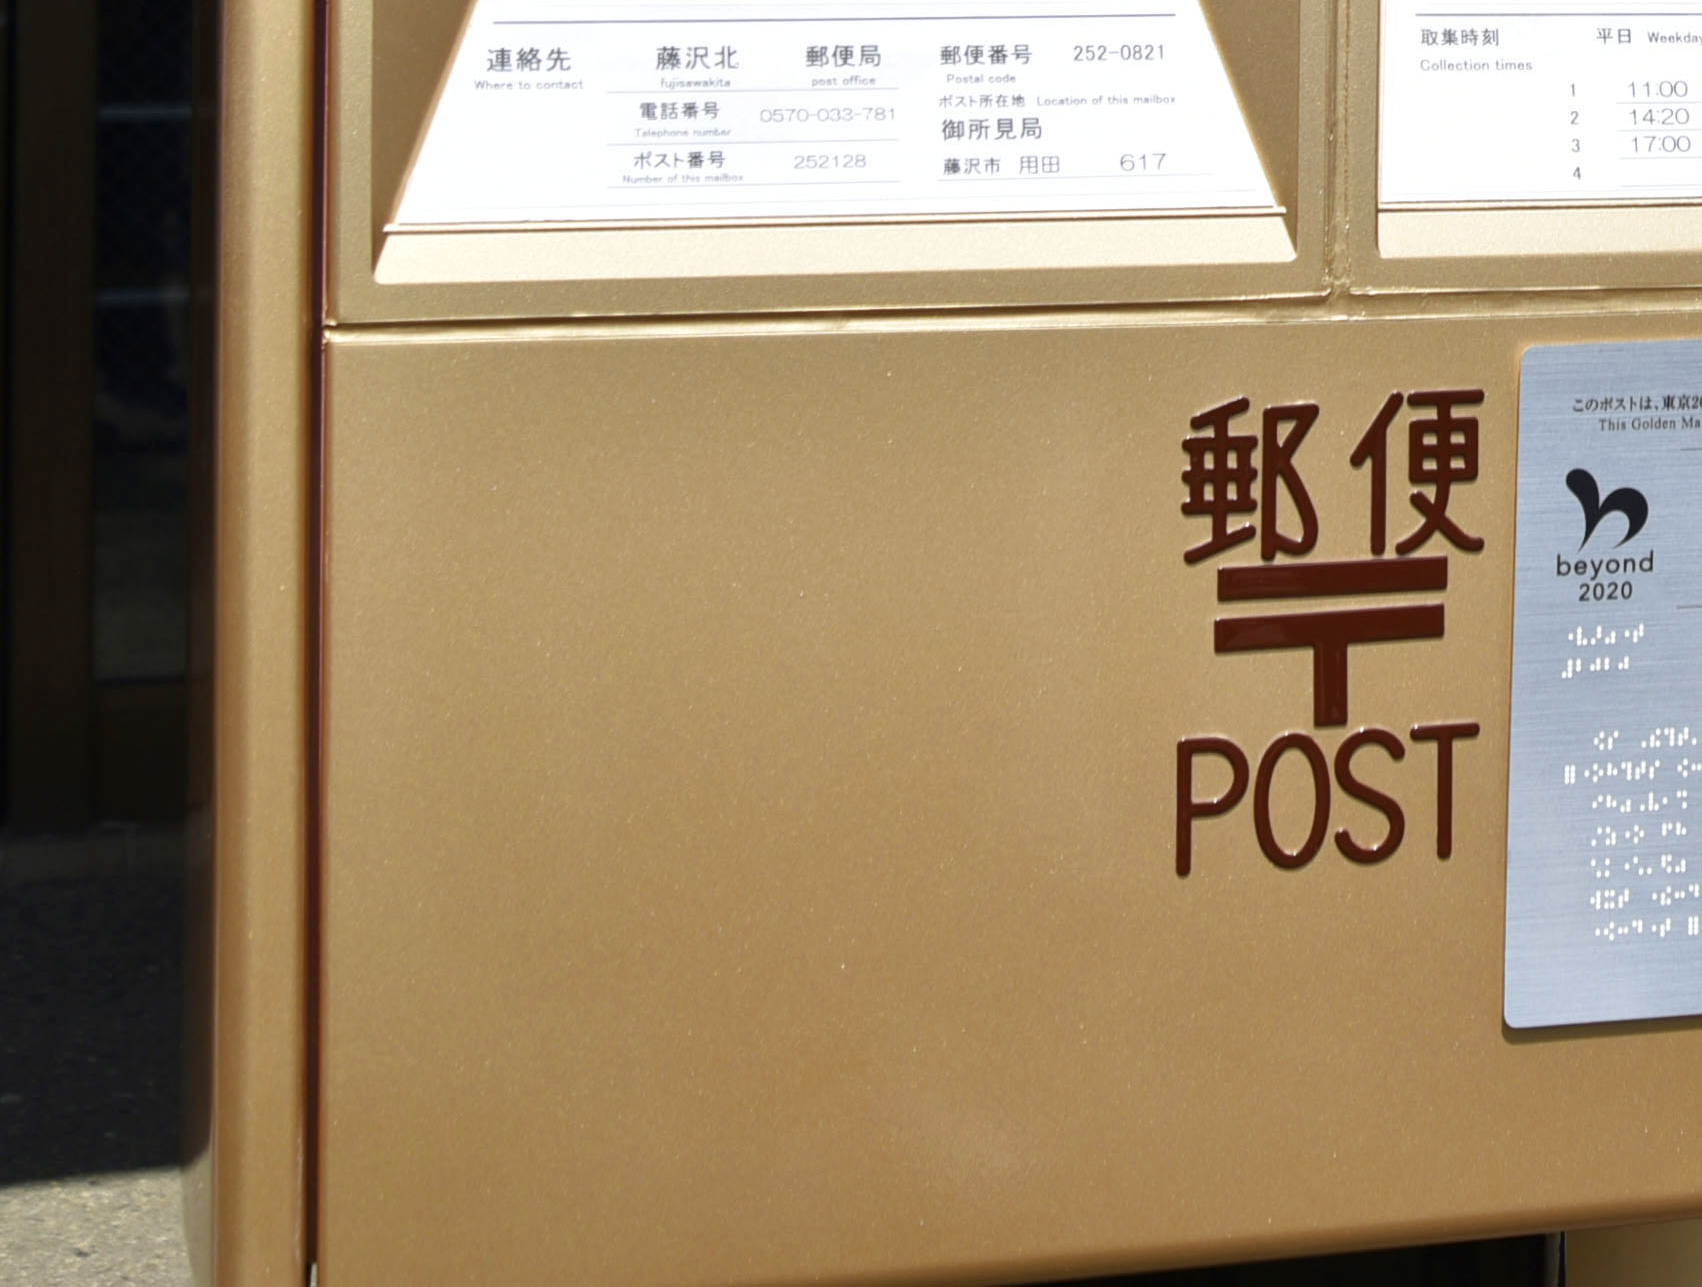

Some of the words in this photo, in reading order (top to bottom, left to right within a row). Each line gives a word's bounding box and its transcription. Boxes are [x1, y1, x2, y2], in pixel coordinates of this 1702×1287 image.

[1420, 28, 1500, 46] 取集時刻
[1596, 27, 1632, 44] 平日
[486, 47, 572, 73] 連絡先
[655, 45, 740, 71] 藤沢北
[805, 44, 882, 69] 郵便局
[940, 44, 1033, 67] 郵便番号
[1073, 44, 1166, 62] 252-0821
[1420, 59, 1490, 72] Collection
[1495, 59, 1533, 72] times
[474, 79, 513, 91] Where
[518, 80, 531, 90] to
[536, 79, 584, 90] contact
[811, 76, 838, 88] post
[842, 75, 877, 87] office
[946, 74, 984, 85] Postal
[988, 74, 1016, 84] code
[1569, 83, 1576, 97] 1
[1627, 80, 1689, 98] 11:00
[938, 94, 1026, 109] ポスト所在地
[1036, 95, 1089, 107] Location
[1091, 94, 1104, 106] of
[1106, 94, 1129, 105] this
[1132, 94, 1177, 105] mailbox
[639, 102, 720, 121] 電話番号
[759, 106, 896, 124] 0570-033-781
[1569, 111, 1579, 125] 2
[1629, 108, 1690, 125] 14:20
[941, 117, 1043, 141] 御所見局
[1571, 139, 1581, 153] 3
[1630, 135, 1691, 153] 17:00
[633, 151, 725, 170] ポスト番号
[793, 153, 868, 170] 252128
[942, 157, 1001, 176] 藤沢市
[1018, 155, 1062, 175] 用田
[1119, 153, 1168, 173] 617
[1572, 166, 1582, 181] 4
[1599, 418, 1627, 431] This
[1631, 416, 1677, 430] Golden
[1181, 388, 1486, 565] 郵便
[1556, 550, 1655, 581] beyond
[1578, 581, 1633, 602] 2020
[1175, 721, 1481, 878] POST
